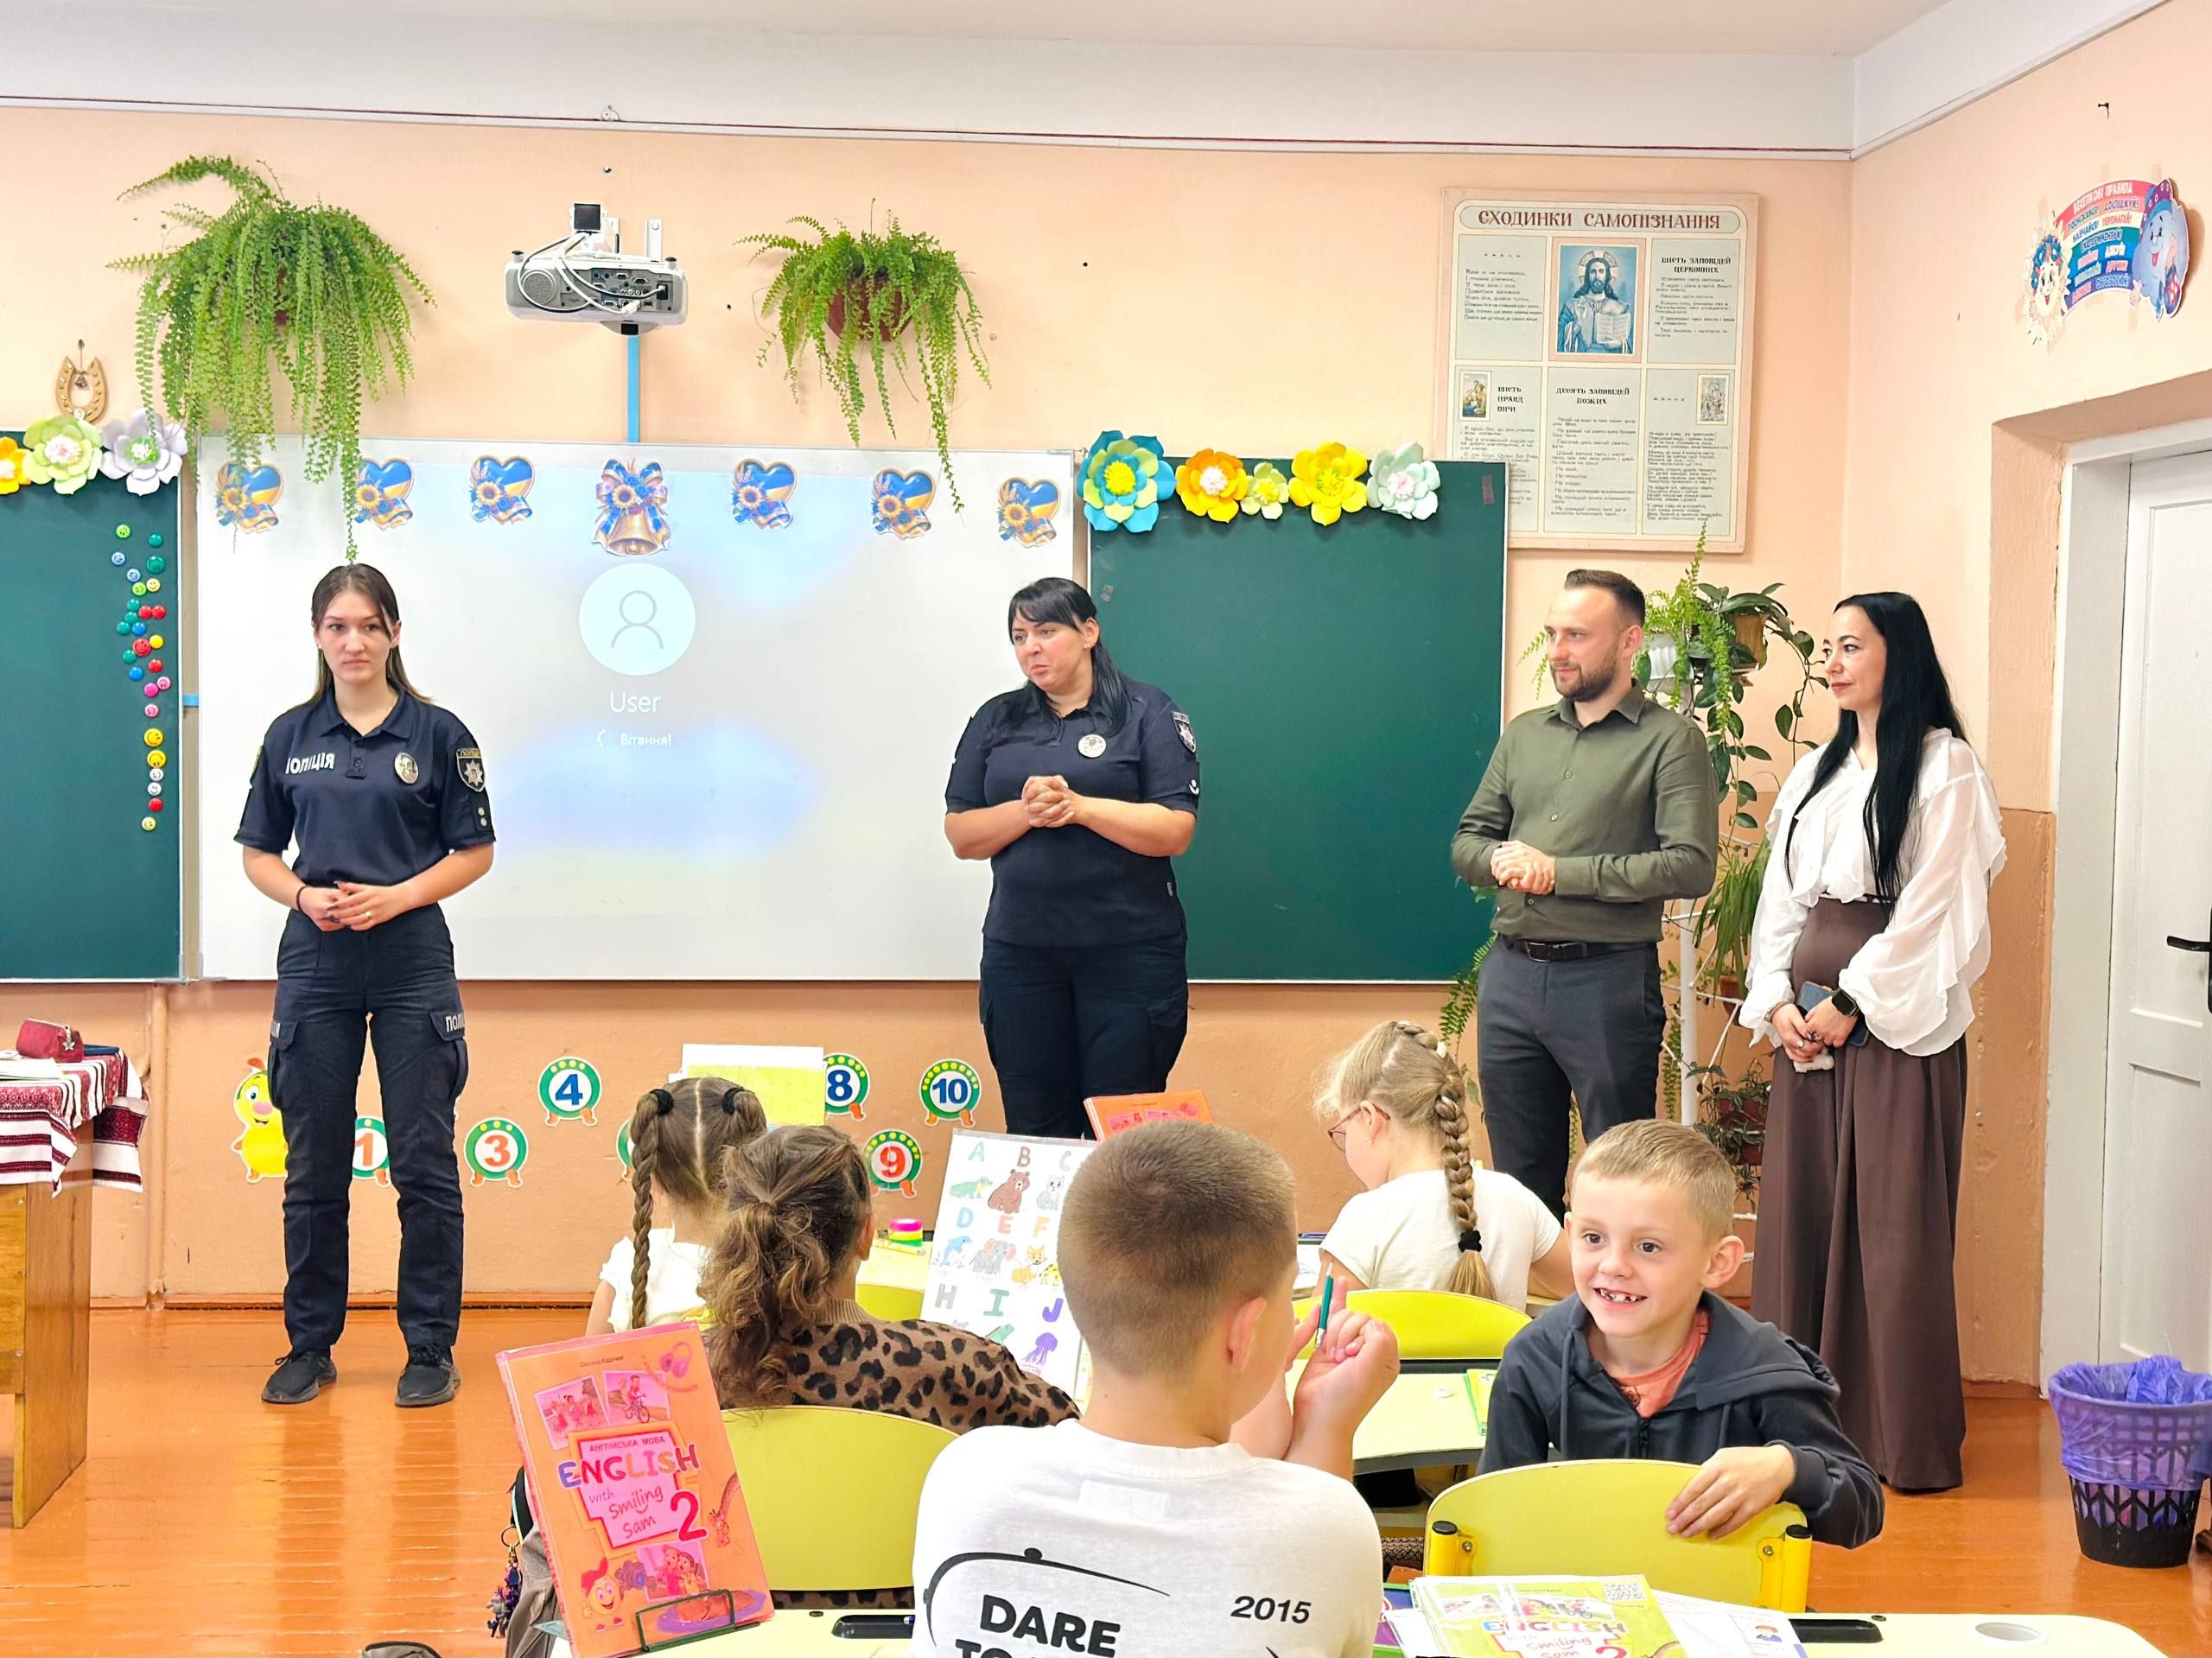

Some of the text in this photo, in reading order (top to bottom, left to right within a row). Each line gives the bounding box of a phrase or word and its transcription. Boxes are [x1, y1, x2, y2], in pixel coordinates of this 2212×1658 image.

[1478, 209, 1720, 229] СХОДИНКИ САМОПІЗНАННЯ
[1497, 396, 1523, 404] ПРАВД
[610, 690, 661, 713] User
[620, 733, 671, 746] Вітання!
[555, 1073, 584, 1106] 4
[827, 1069, 854, 1102] 8
[931, 1077, 969, 1104] 10
[354, 1132, 374, 1166] 1
[484, 1134, 511, 1167] 3
[880, 1145, 906, 1178] 9
[968, 1141, 1072, 1172] A B C
[956, 1207, 1051, 1237] D E F
[935, 1283, 1064, 1322] H I J
[590, 1436, 666, 1452] АНГЛІЙСЬКА МОВА
[558, 1444, 700, 1488] ENGLISH
[588, 1488, 615, 1503] with
[609, 1486, 664, 1520] Smiling
[622, 1515, 657, 1540] Sam
[670, 1490, 709, 1542] 2
[1230, 1595, 1313, 1625] 2015
[980, 1594, 1121, 1657] DARE
[1527, 1636, 1592, 1651] Smiling
